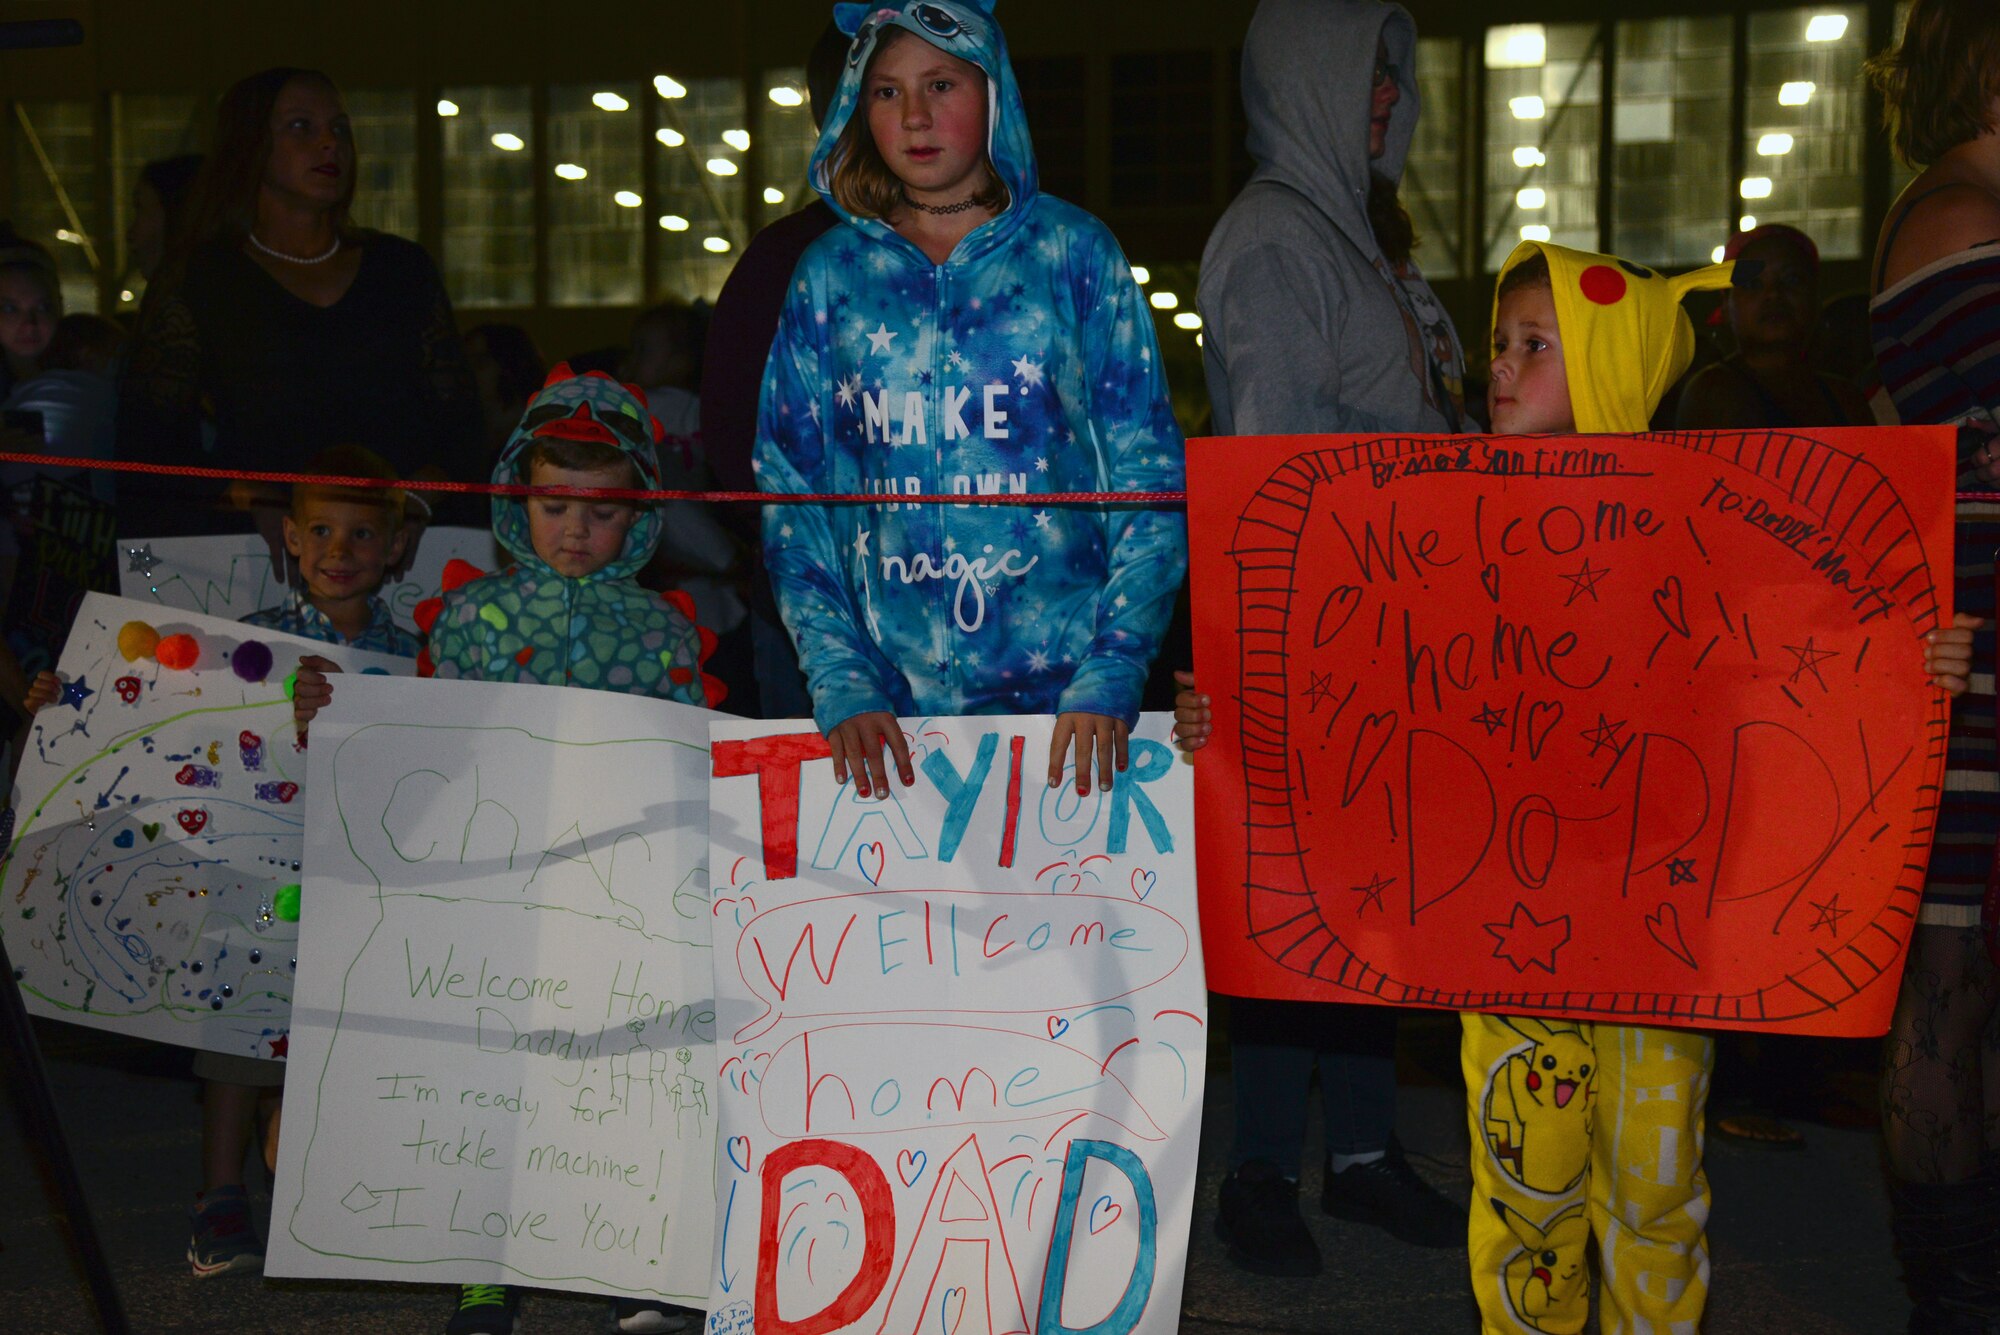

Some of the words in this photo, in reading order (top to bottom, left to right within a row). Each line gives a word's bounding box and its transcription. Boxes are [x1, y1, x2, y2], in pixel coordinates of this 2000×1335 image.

[863, 385, 1009, 445] MAKE
[865, 477, 921, 512] OUR
[953, 473, 1027, 508] OWN
[406, 938, 573, 1009] Welcome
[608, 960, 716, 1042] Home
[377, 1075, 439, 1106] I'm
[460, 1085, 540, 1128] ready
[570, 1087, 621, 1125] for
[805, 1032, 1107, 1132] home
[402, 1119, 504, 1170] tickle
[368, 1187, 428, 1230] I
[450, 1190, 557, 1243] Love
[756, 1134, 1157, 1335] DAD
